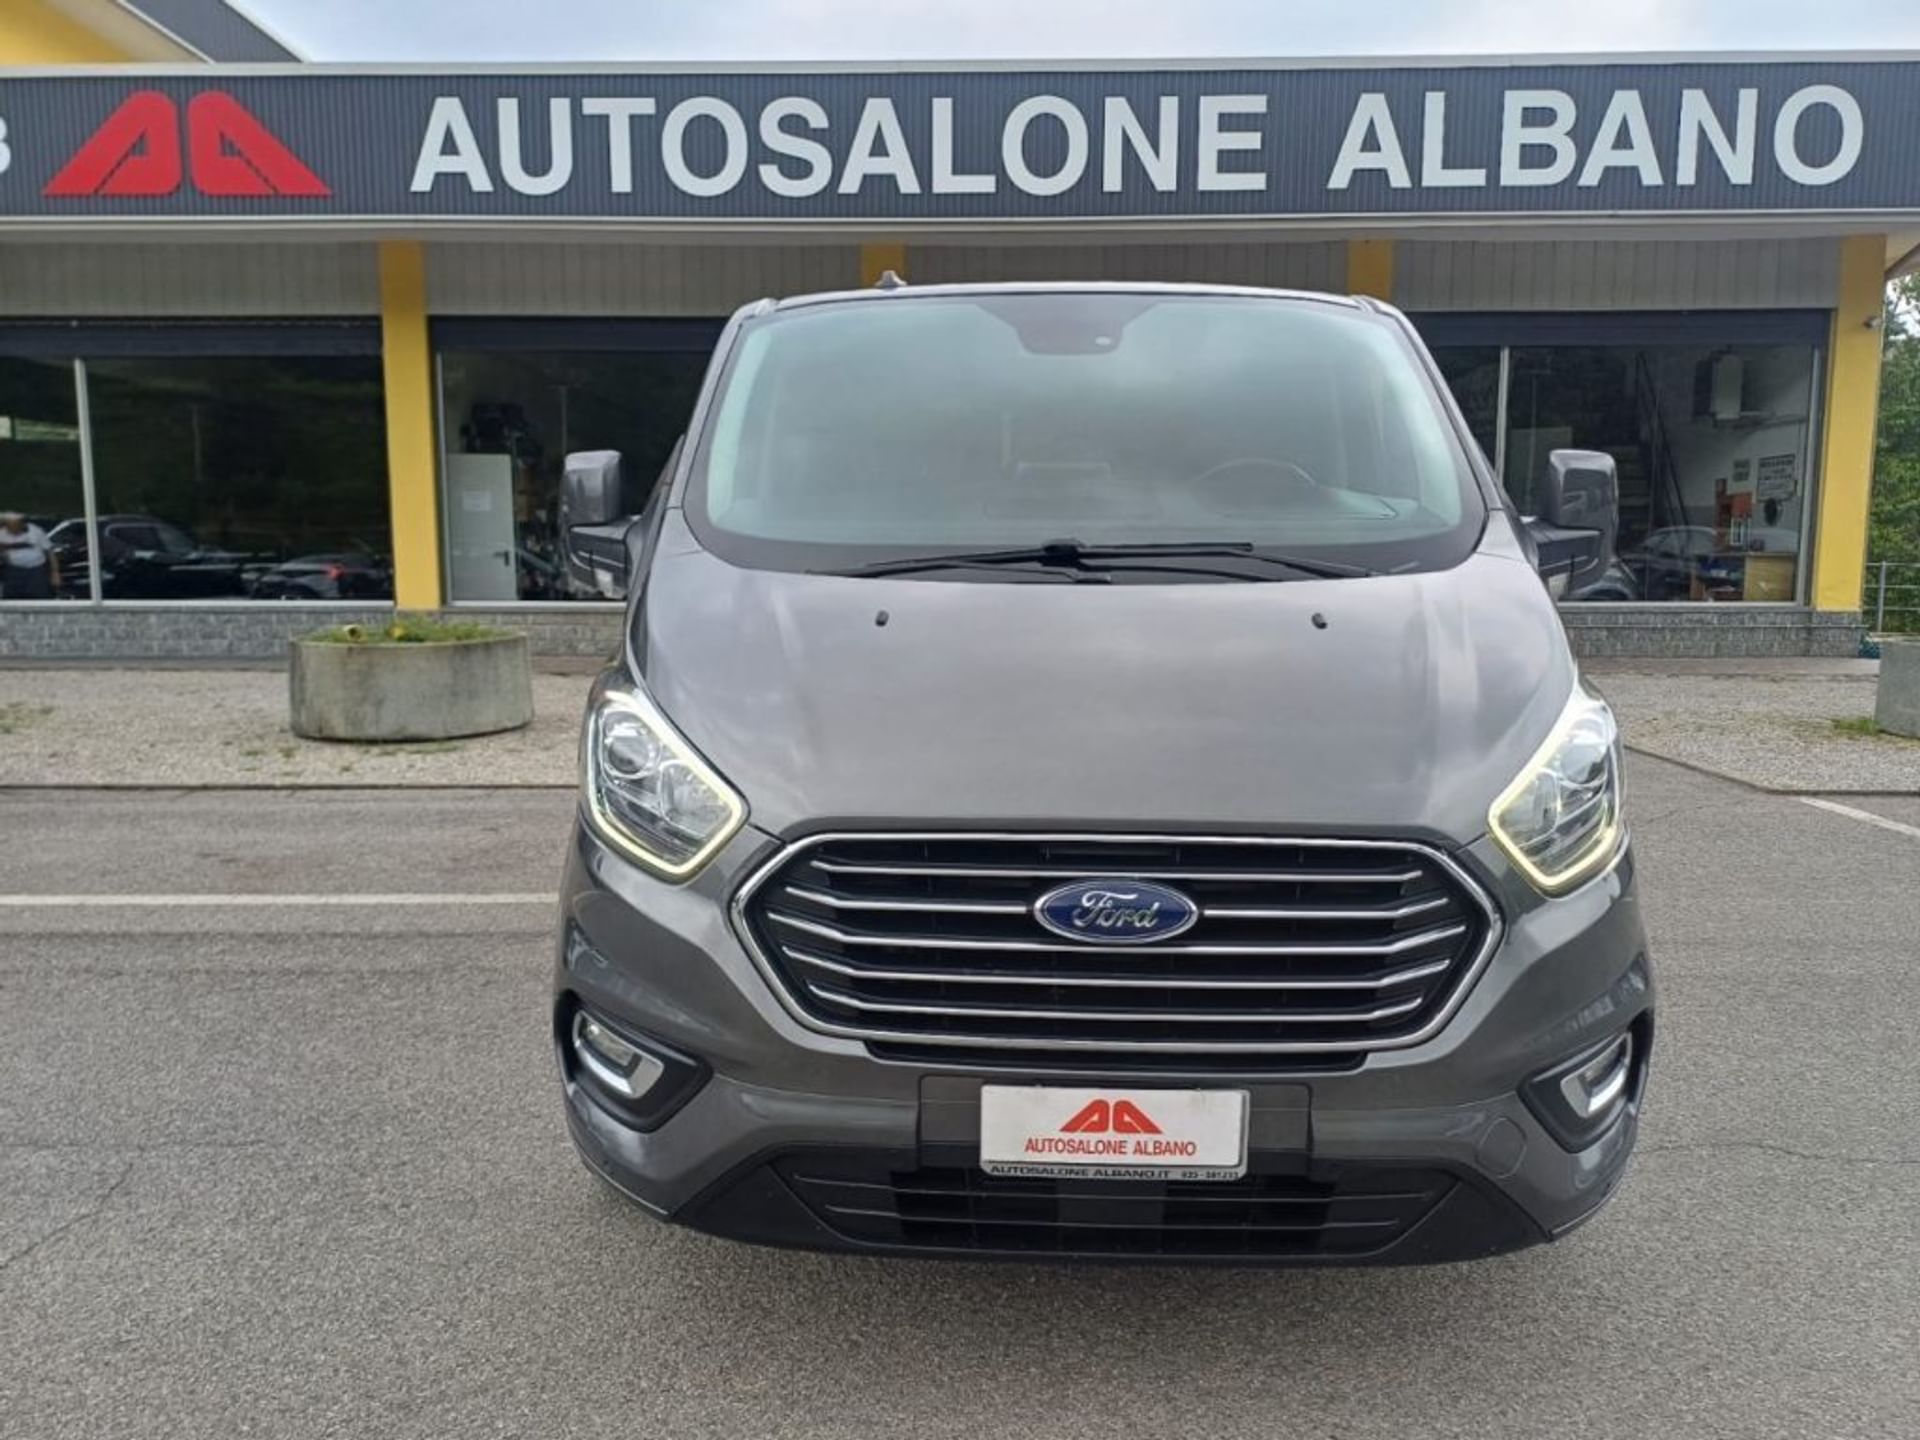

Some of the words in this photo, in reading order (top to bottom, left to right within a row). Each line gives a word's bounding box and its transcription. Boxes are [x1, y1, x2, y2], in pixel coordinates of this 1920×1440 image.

[410, 94, 1268, 197] AUTOSALONE
[1327, 84, 1864, 190] ALBANO
[1072, 890, 1160, 928] Ford
[1024, 1137, 1128, 1155] AUTOSALONE
[1133, 1140, 1197, 1156] ALBANO
[990, 1165, 1088, 1178] AUTOSALONE
